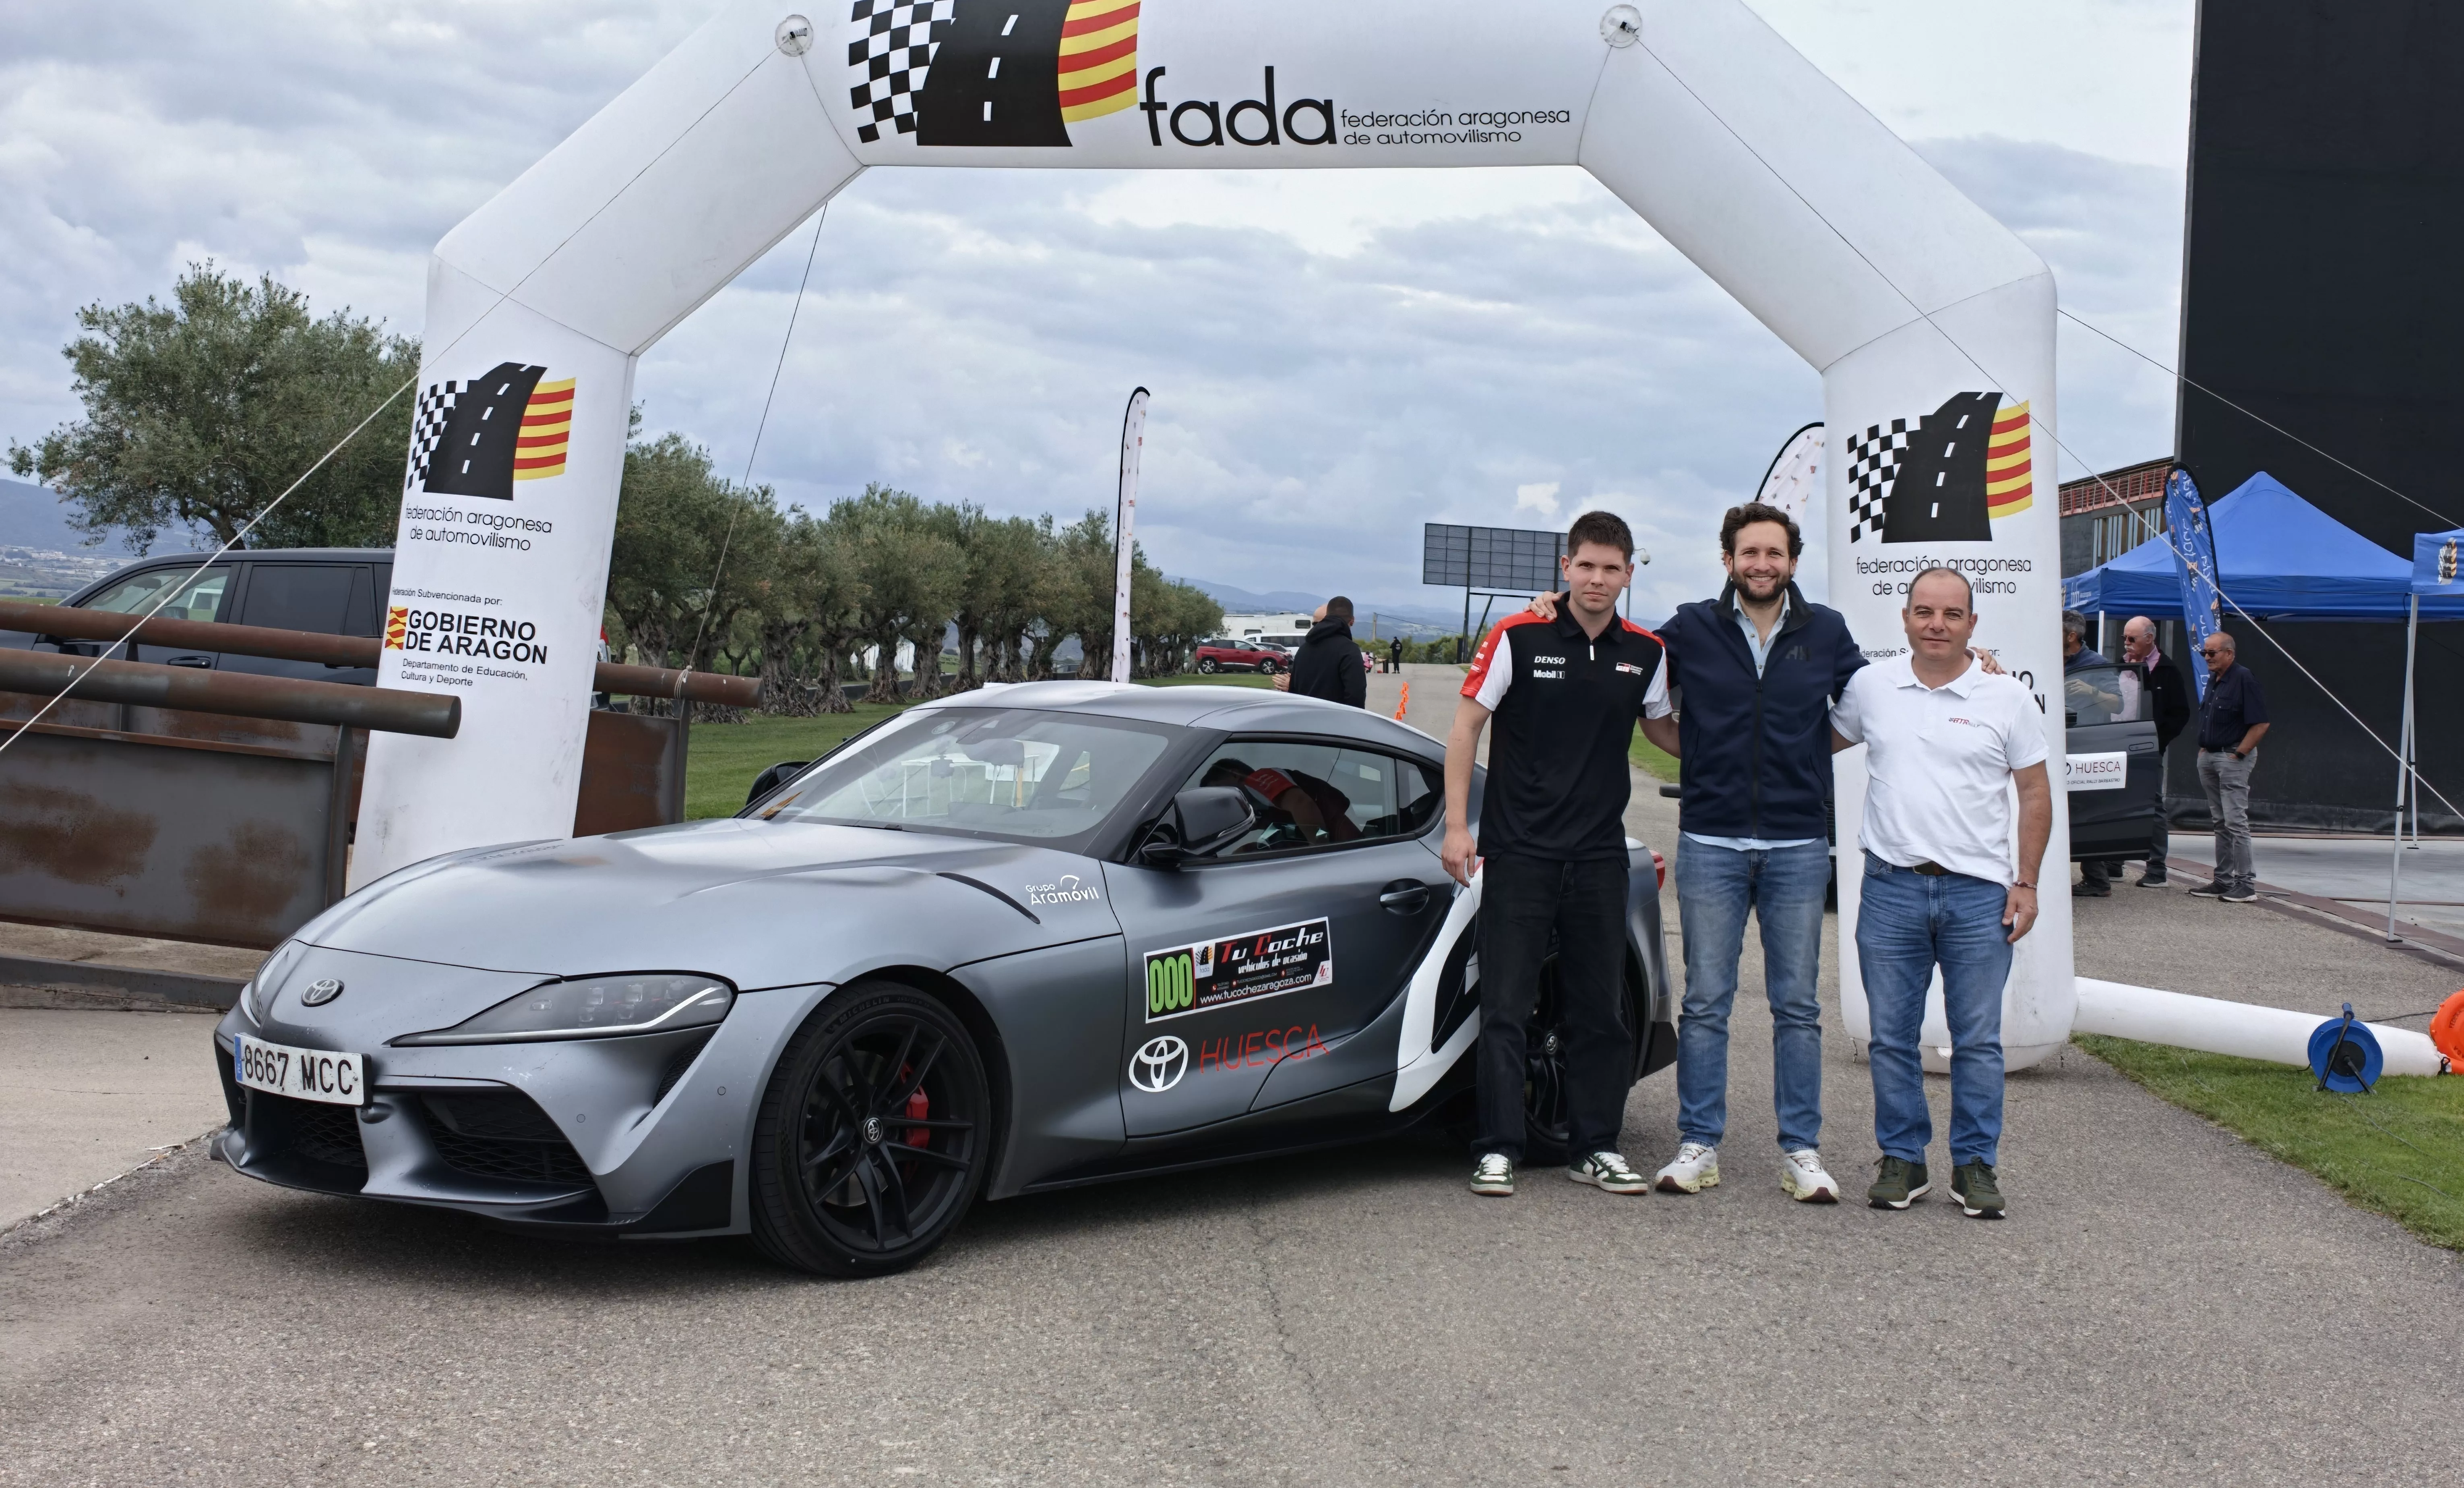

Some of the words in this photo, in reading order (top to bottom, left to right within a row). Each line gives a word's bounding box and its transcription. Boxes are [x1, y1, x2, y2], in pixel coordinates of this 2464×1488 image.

[1139, 66, 1337, 147] fada
[1340, 109, 1452, 128] federación
[1458, 110, 1570, 128] aragonesa
[1344, 131, 1371, 145] de
[1377, 129, 1521, 144] automovilismo
[405, 503, 462, 522] federación
[467, 512, 552, 533] aragonesa
[410, 526, 423, 540] de
[426, 528, 531, 551] automovilismo
[1856, 555, 1941, 574] federación
[1947, 559, 2031, 575] aragonesa
[418, 589, 481, 603] Subvencionada
[484, 597, 502, 606] por:
[1873, 580, 1892, 595] de
[409, 610, 536, 642] GOBIERNO
[405, 631, 432, 652] DE
[437, 635, 547, 664] ARAGON
[403, 658, 459, 673] Departamento
[461, 665, 473, 674] de
[477, 666, 528, 681] Educación,
[1534, 656, 1566, 664] DENSO
[401, 671, 426, 681] Cultura
[436, 675, 473, 687] Deporte
[1533, 670, 1556, 679] Mobil
[2075, 761, 2121, 774] HUESCA
[1025, 884, 1056, 893] Grupo
[1221, 941, 1247, 964] Tu
[1253, 927, 1324, 956] Coche
[1149, 953, 1193, 1013] 000
[1200, 973, 1312, 1004] www.tucochezaragoza.com
[839, 996, 890, 1024] MICHELIN
[1199, 1023, 1329, 1074] HUESCA
[244, 1044, 289, 1087] 8667
[301, 1054, 353, 1095] MCC
